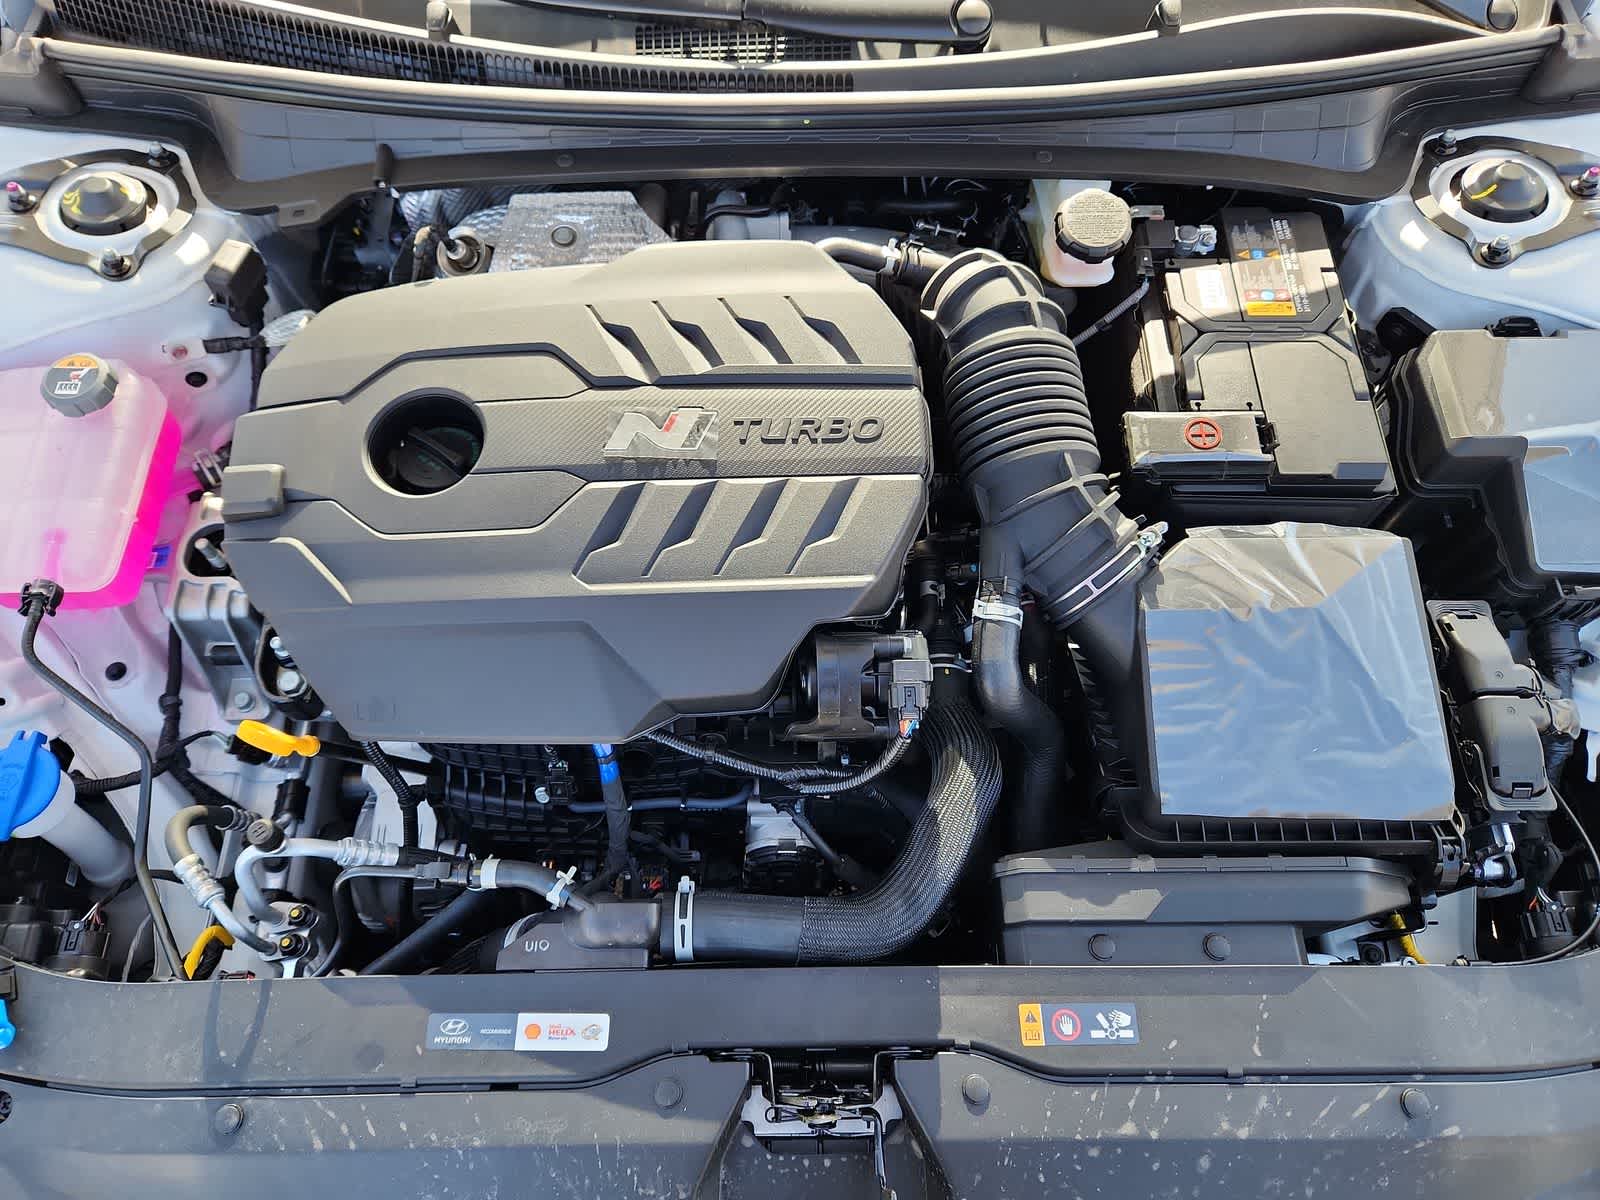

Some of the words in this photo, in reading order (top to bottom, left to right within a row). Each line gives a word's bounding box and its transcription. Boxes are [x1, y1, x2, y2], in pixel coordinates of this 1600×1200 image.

[733, 416, 885, 445] TURBO
[547, 1028, 576, 1037] HELIX
[434, 1036, 472, 1044] HYUNDAI
